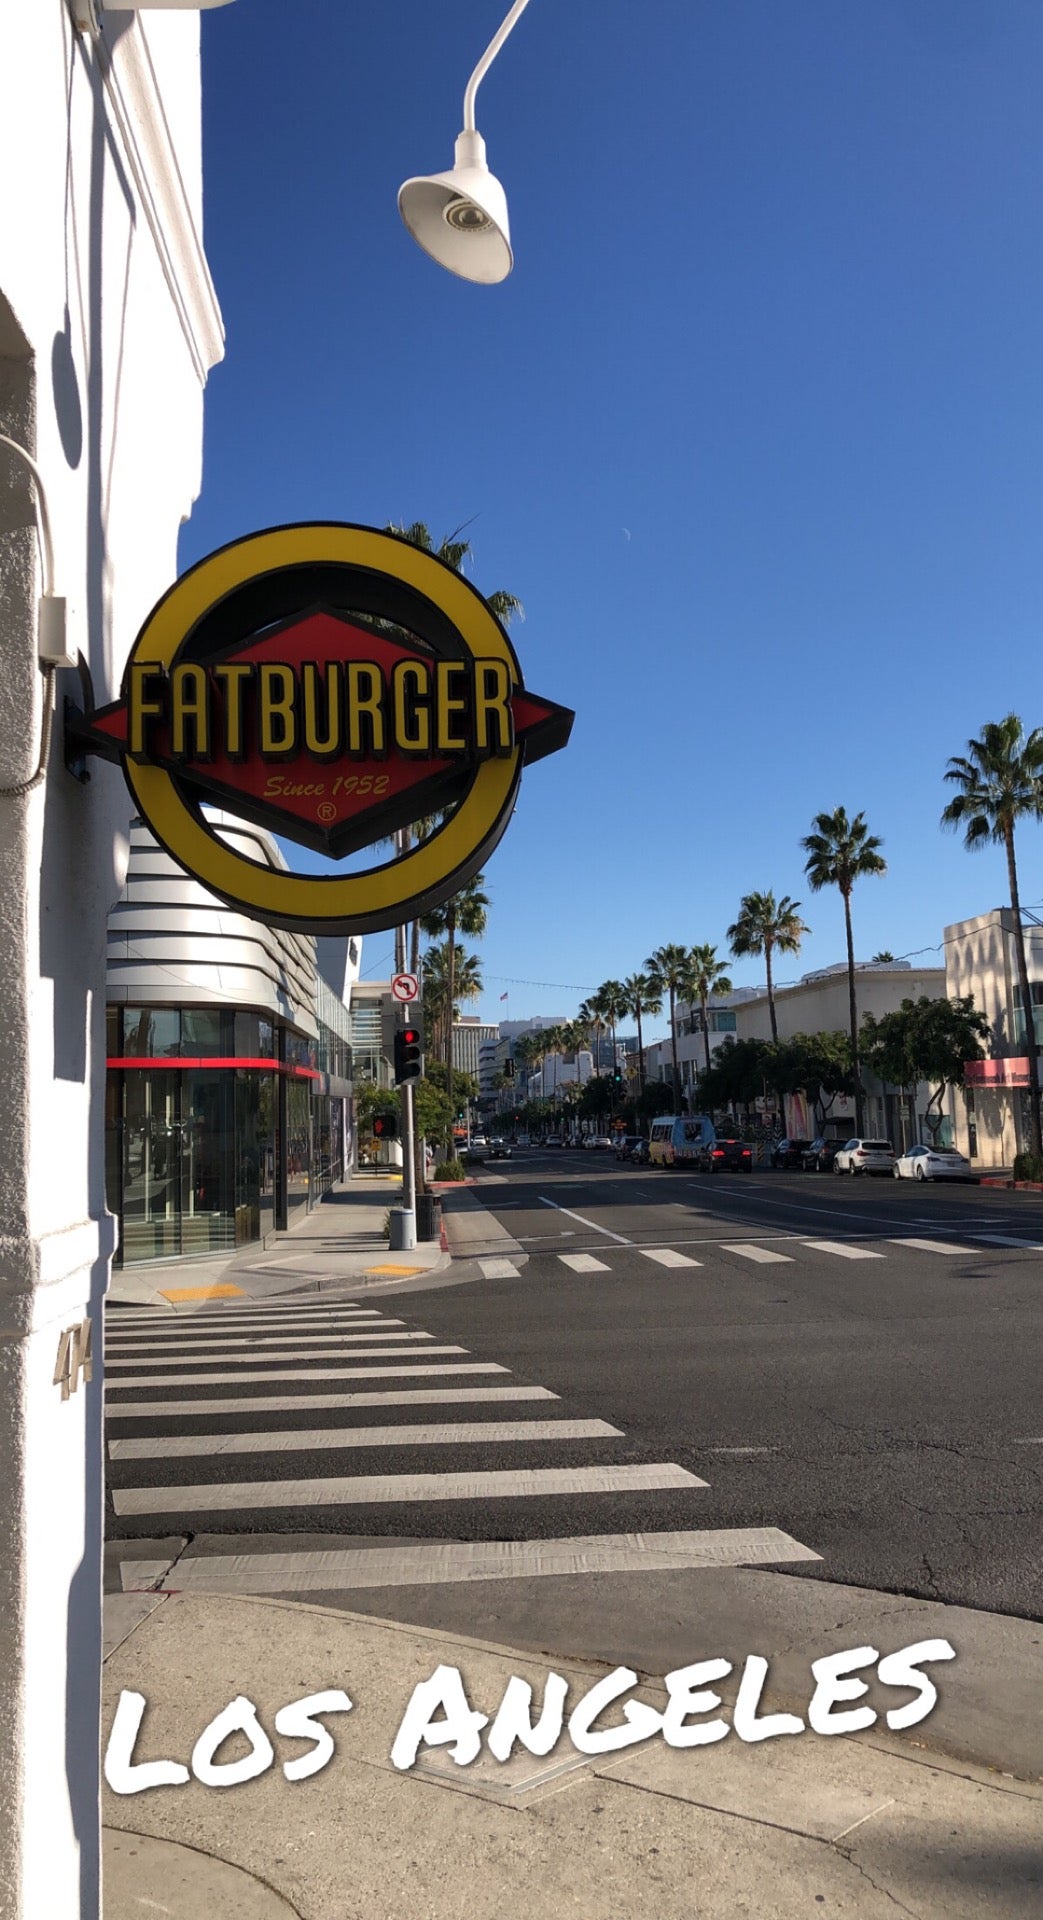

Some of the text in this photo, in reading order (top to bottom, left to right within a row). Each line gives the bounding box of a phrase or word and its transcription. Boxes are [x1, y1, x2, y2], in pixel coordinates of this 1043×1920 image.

[128, 658, 514, 755] FATBURGER
[263, 775, 390, 797] Since 1952
